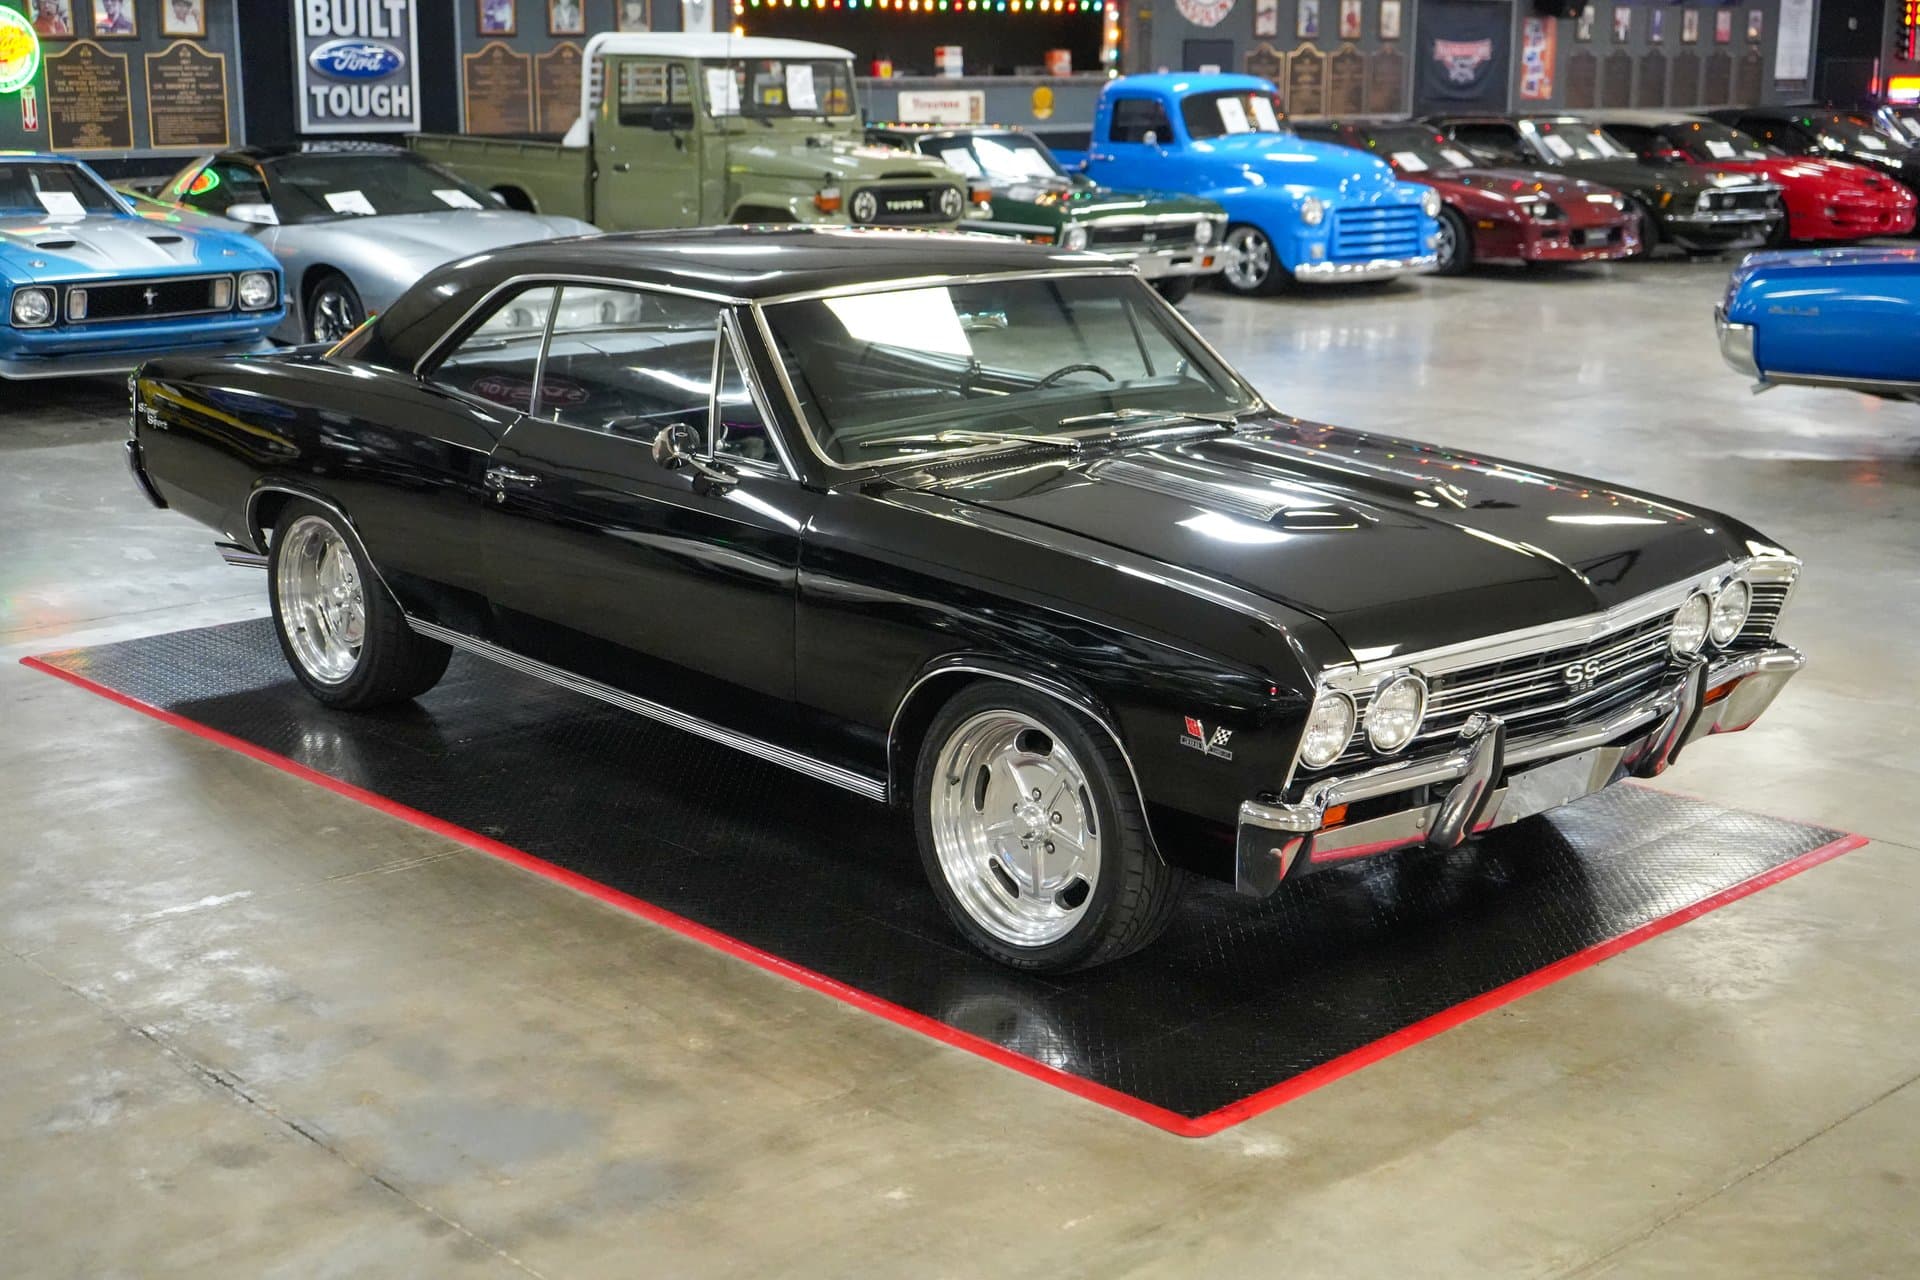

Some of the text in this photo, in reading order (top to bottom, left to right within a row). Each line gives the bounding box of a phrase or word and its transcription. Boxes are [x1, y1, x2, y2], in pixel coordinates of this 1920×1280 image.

[306, 0, 406, 37] BUILT
[334, 47, 384, 71] Ford
[311, 86, 410, 117] TOUGH
[1565, 659, 1600, 684] SS
